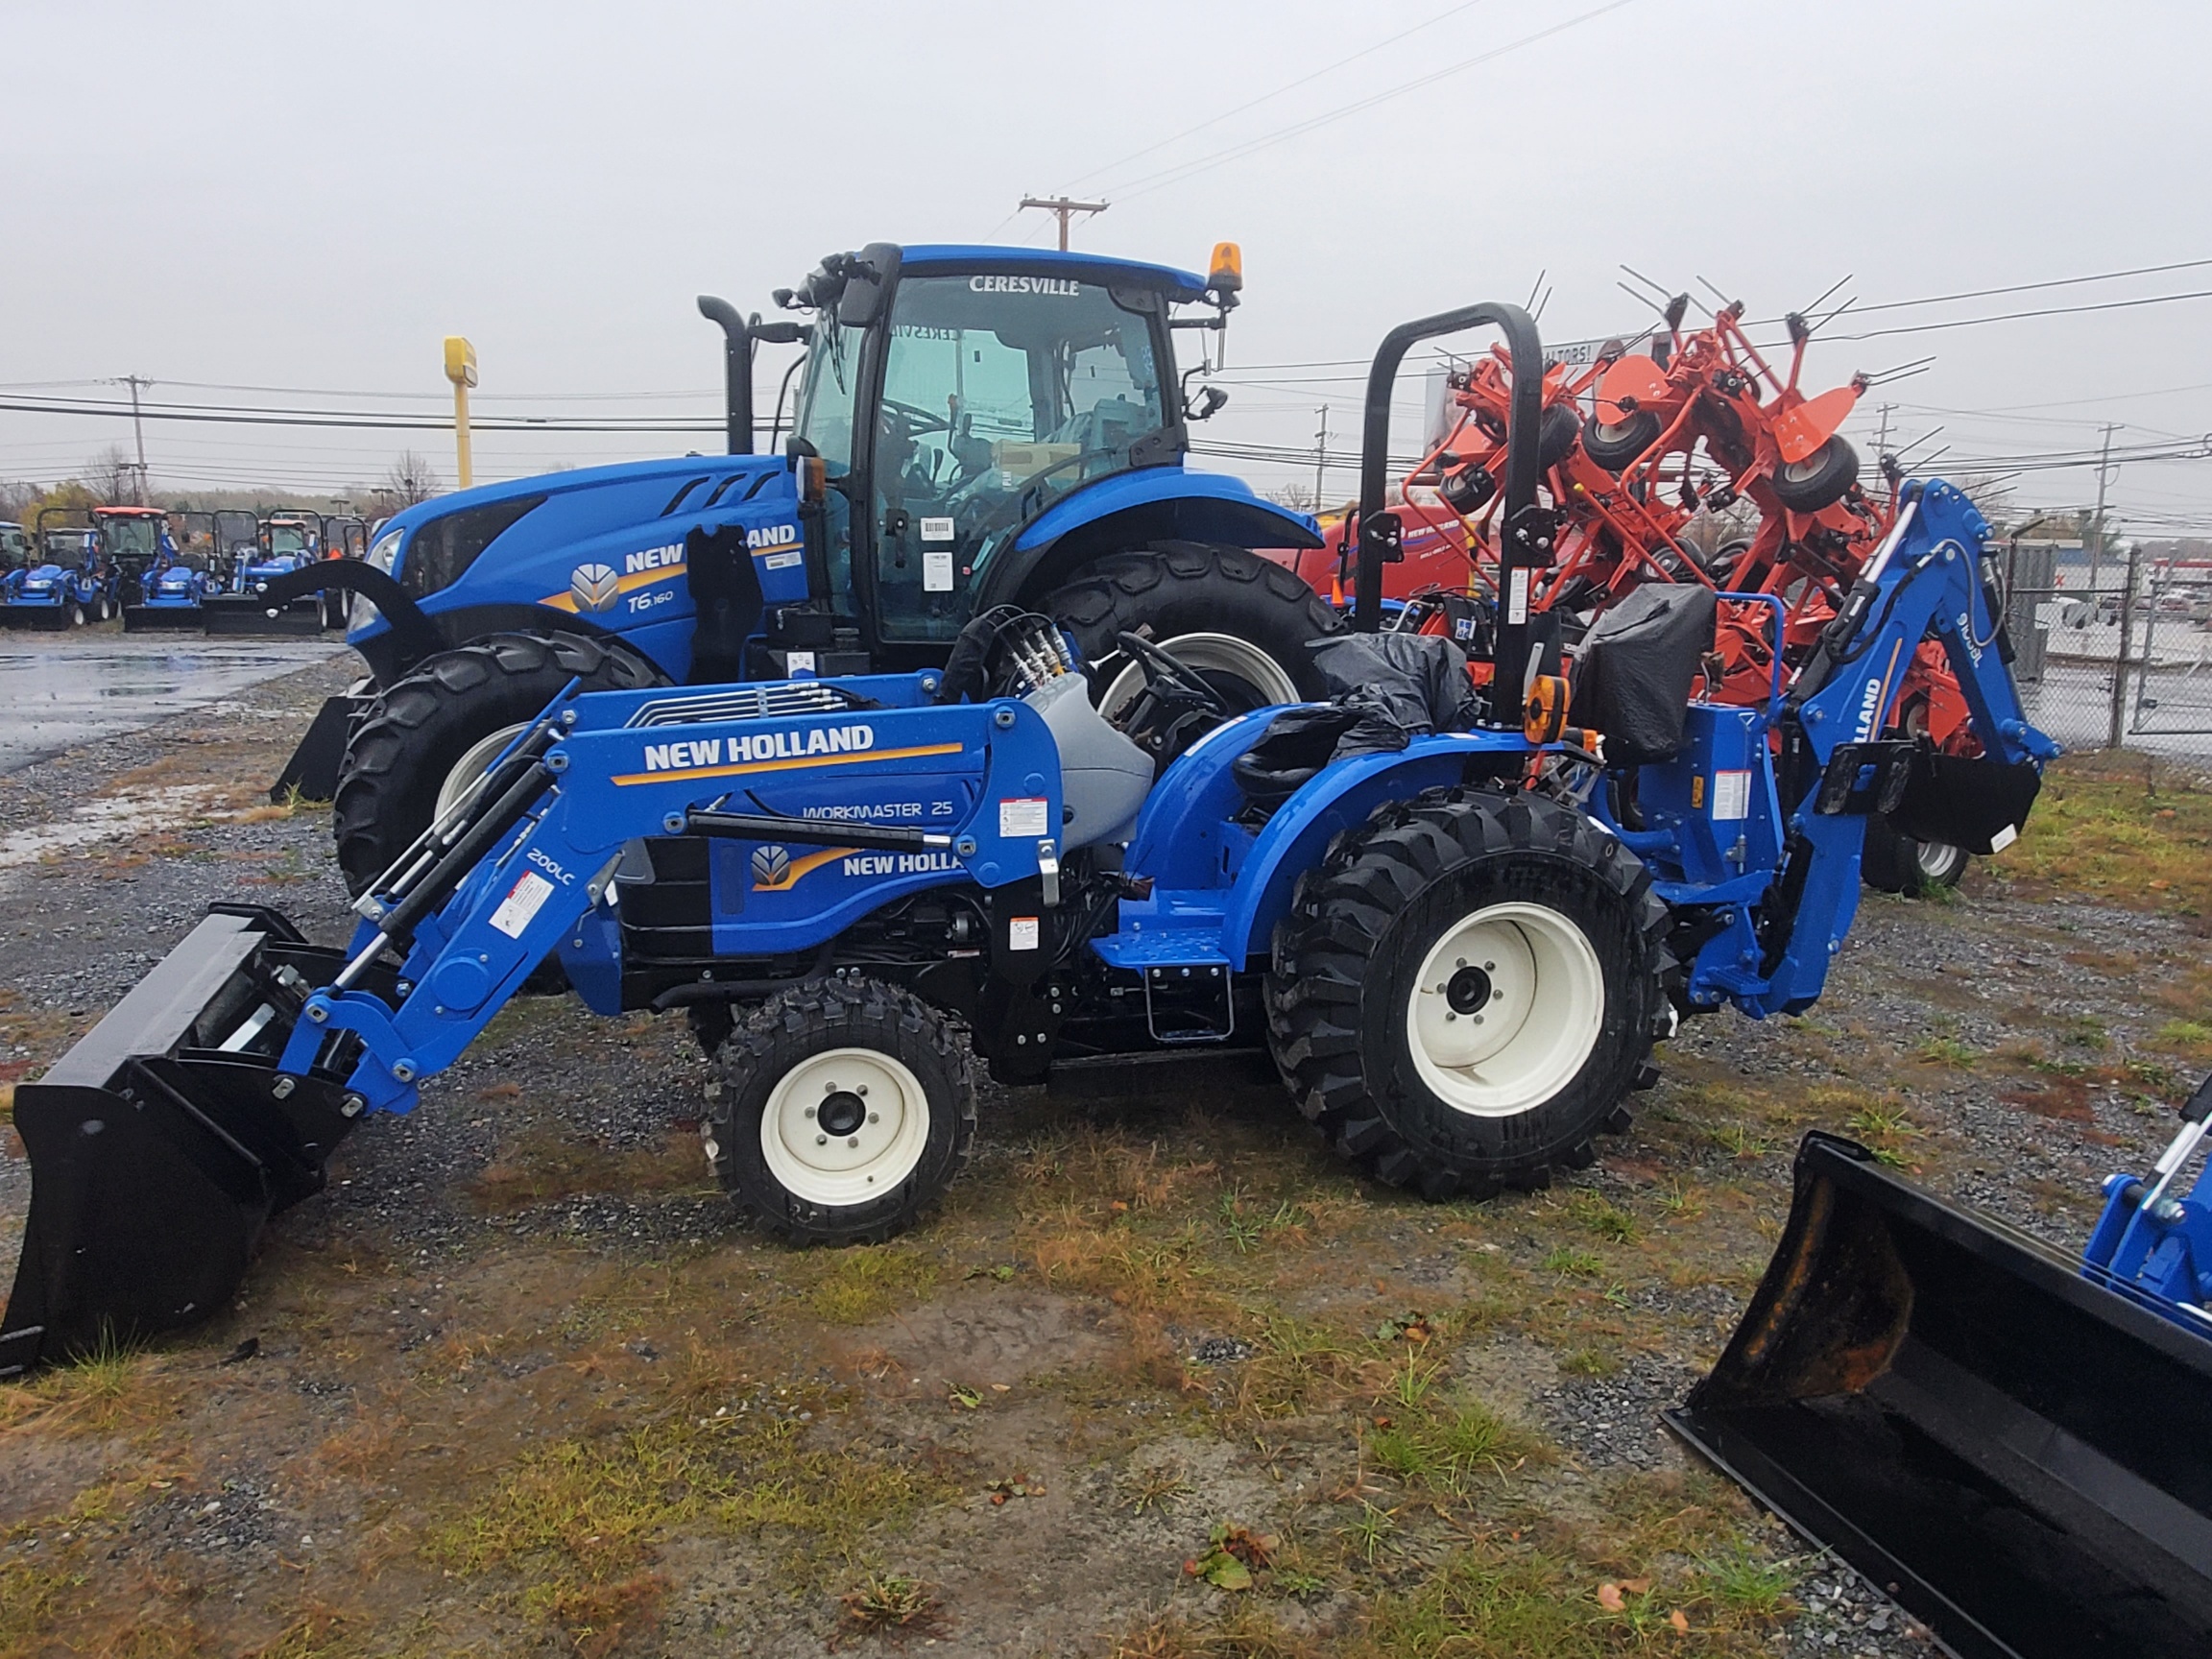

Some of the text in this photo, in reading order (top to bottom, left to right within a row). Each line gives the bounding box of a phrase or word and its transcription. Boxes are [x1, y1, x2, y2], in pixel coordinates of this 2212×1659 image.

[969, 275, 1080, 297] CERESVILLE
[1407, 526, 1426, 539] NEW
[625, 542, 685, 573] NEW
[628, 590, 673, 613] T6.160
[644, 724, 874, 771] NEW HOLLAND
[803, 802, 953, 819] WORKMASTER 25
[526, 848, 576, 886] 200LC
[844, 855, 895, 876] NEW
